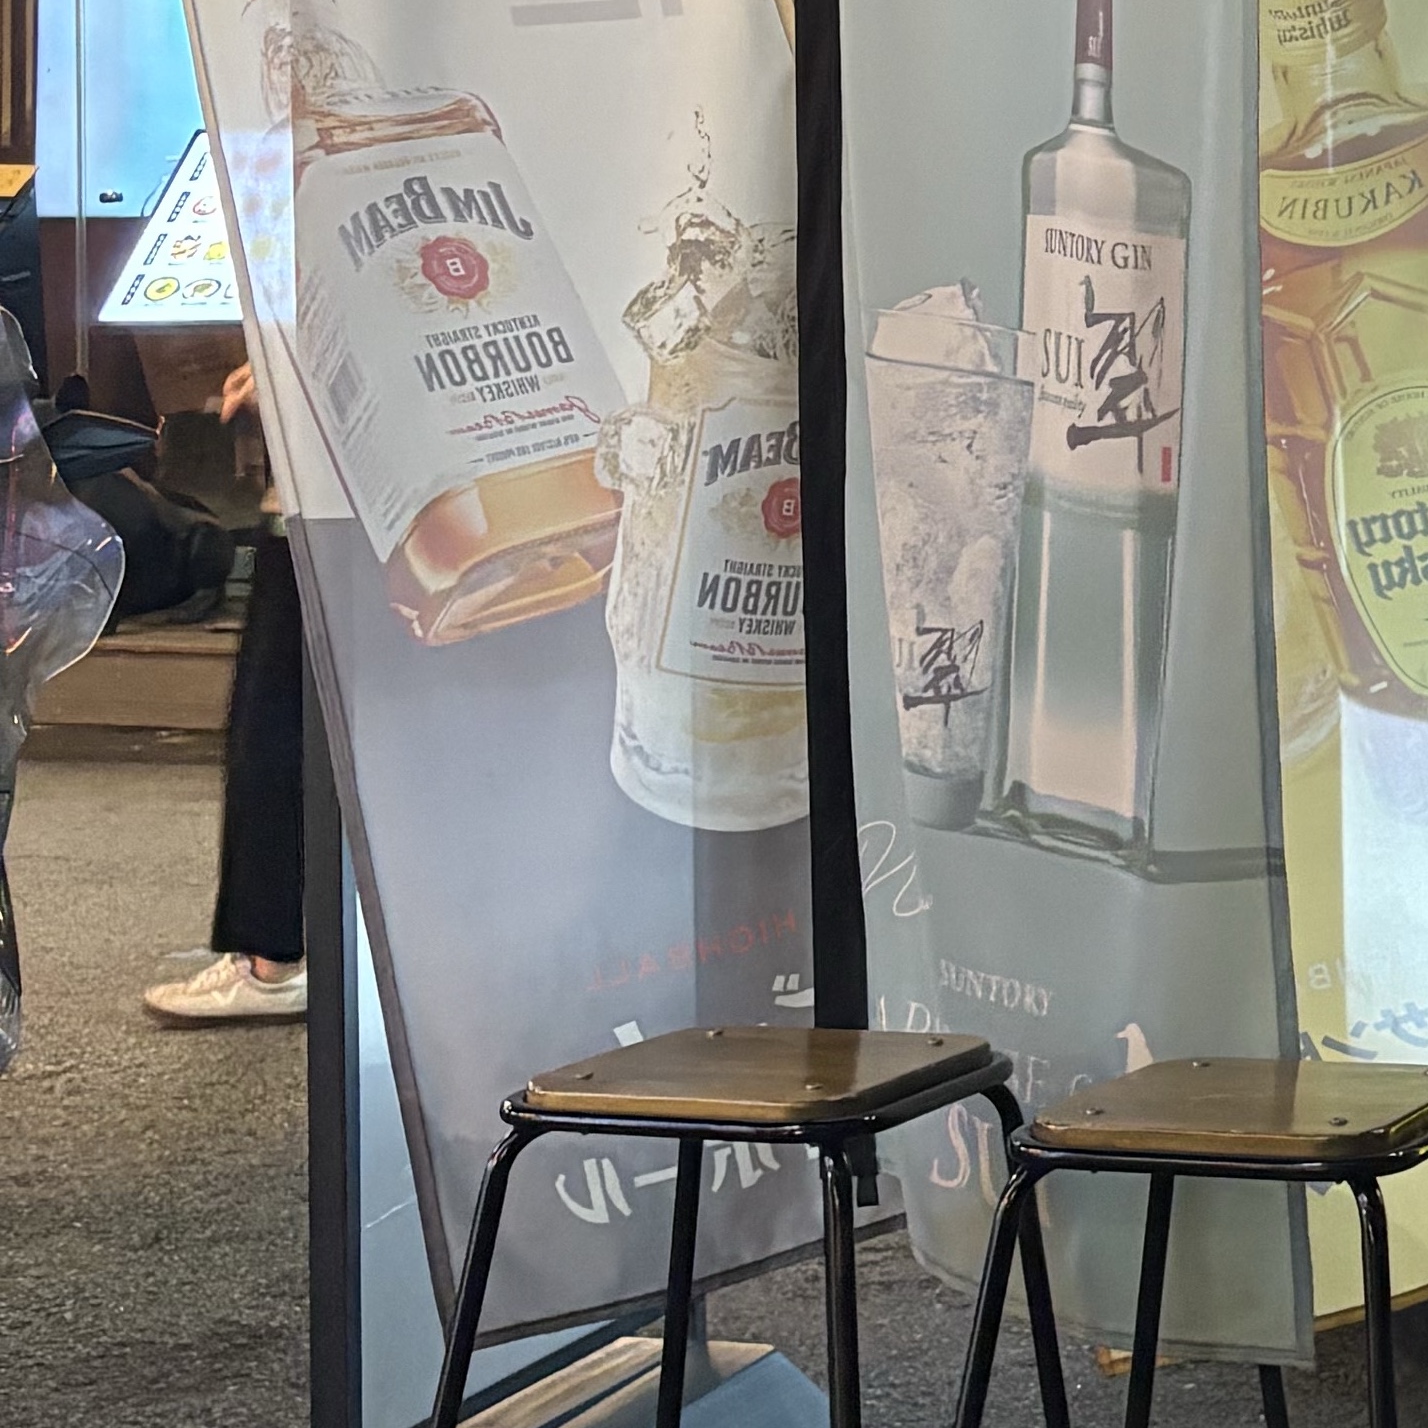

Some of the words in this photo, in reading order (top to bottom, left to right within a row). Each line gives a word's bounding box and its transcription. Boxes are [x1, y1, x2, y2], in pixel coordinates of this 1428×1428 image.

[1044, 227, 1105, 266] SUNTORY
[1110, 240, 1152, 273] GIN
[1040, 328, 1087, 391] SUI
[939, 959, 1053, 1017] SUNTORY
